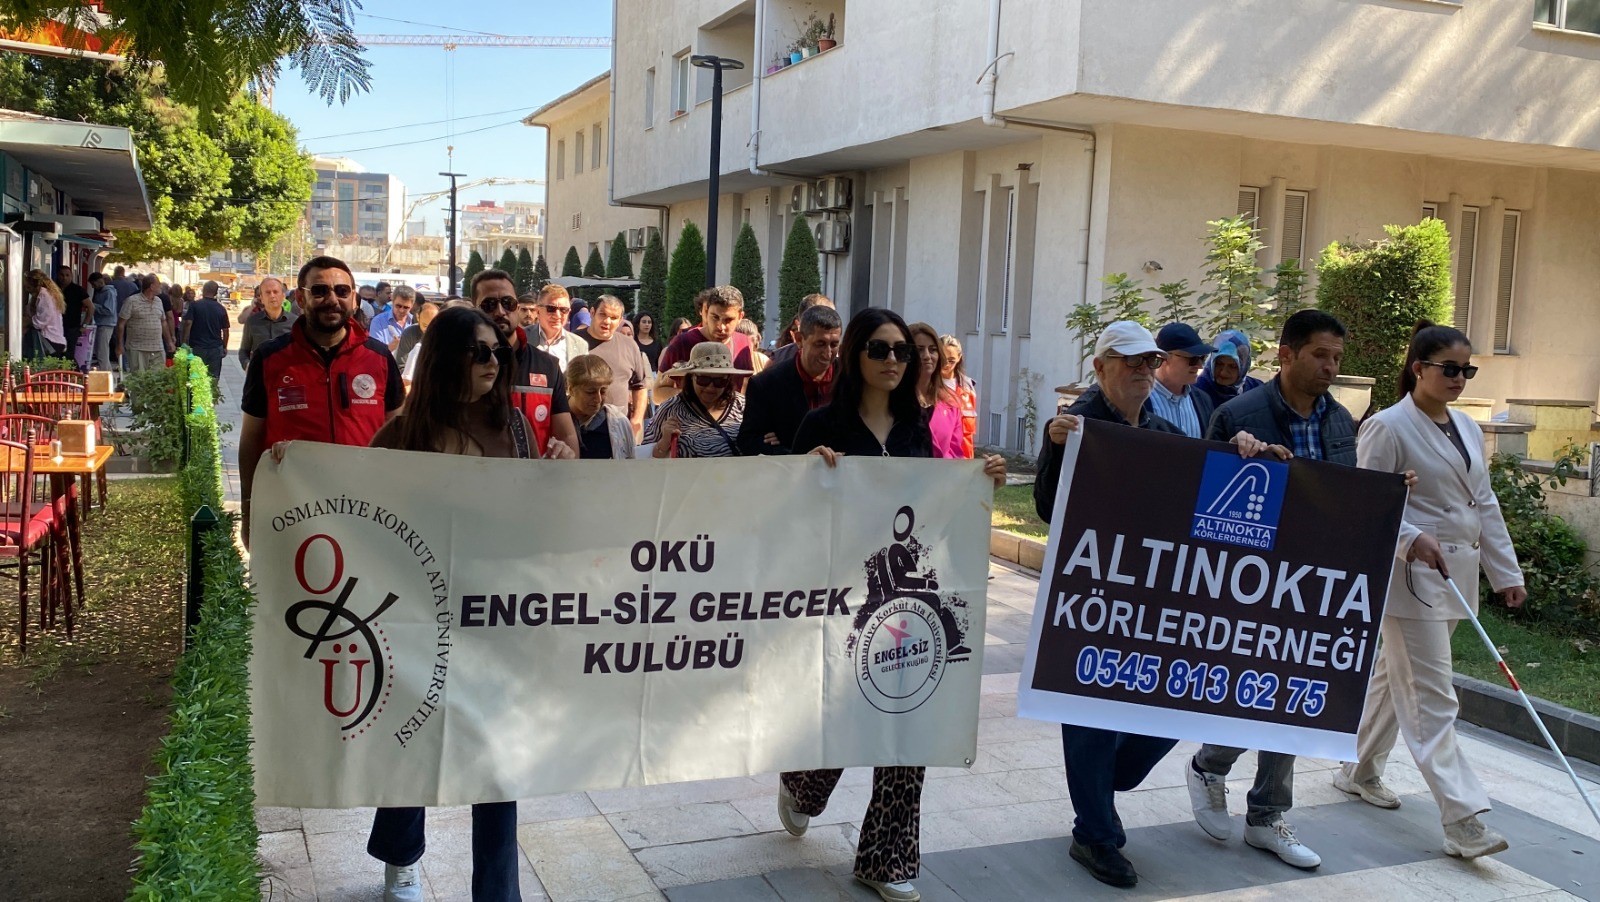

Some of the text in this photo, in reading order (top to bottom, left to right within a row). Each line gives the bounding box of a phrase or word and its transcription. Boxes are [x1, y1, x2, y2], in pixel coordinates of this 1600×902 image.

[1196, 518, 1271, 540] ALTINOKTA
[1228, 510, 1242, 519] 1950
[630, 534, 715, 573] OKÜ
[1062, 528, 1372, 623] ALTINOKTA
[272, 494, 454, 749] OSMANİYE KORKUT ATA ÜNİVERSİTESİ
[460, 583, 853, 628] ENGEL-SİZ GELECEK
[861, 602, 943, 681] Osmaniye Korkut Ata Üniversitesi
[874, 638, 929, 665] ENGEL-SİZ
[1052, 588, 1368, 673] KÖRLERDERNEĞİ
[583, 632, 744, 675] KULÜBÜ
[881, 660, 906, 673] GELECEK
[1075, 646, 1329, 717] 0545 813 62 75
